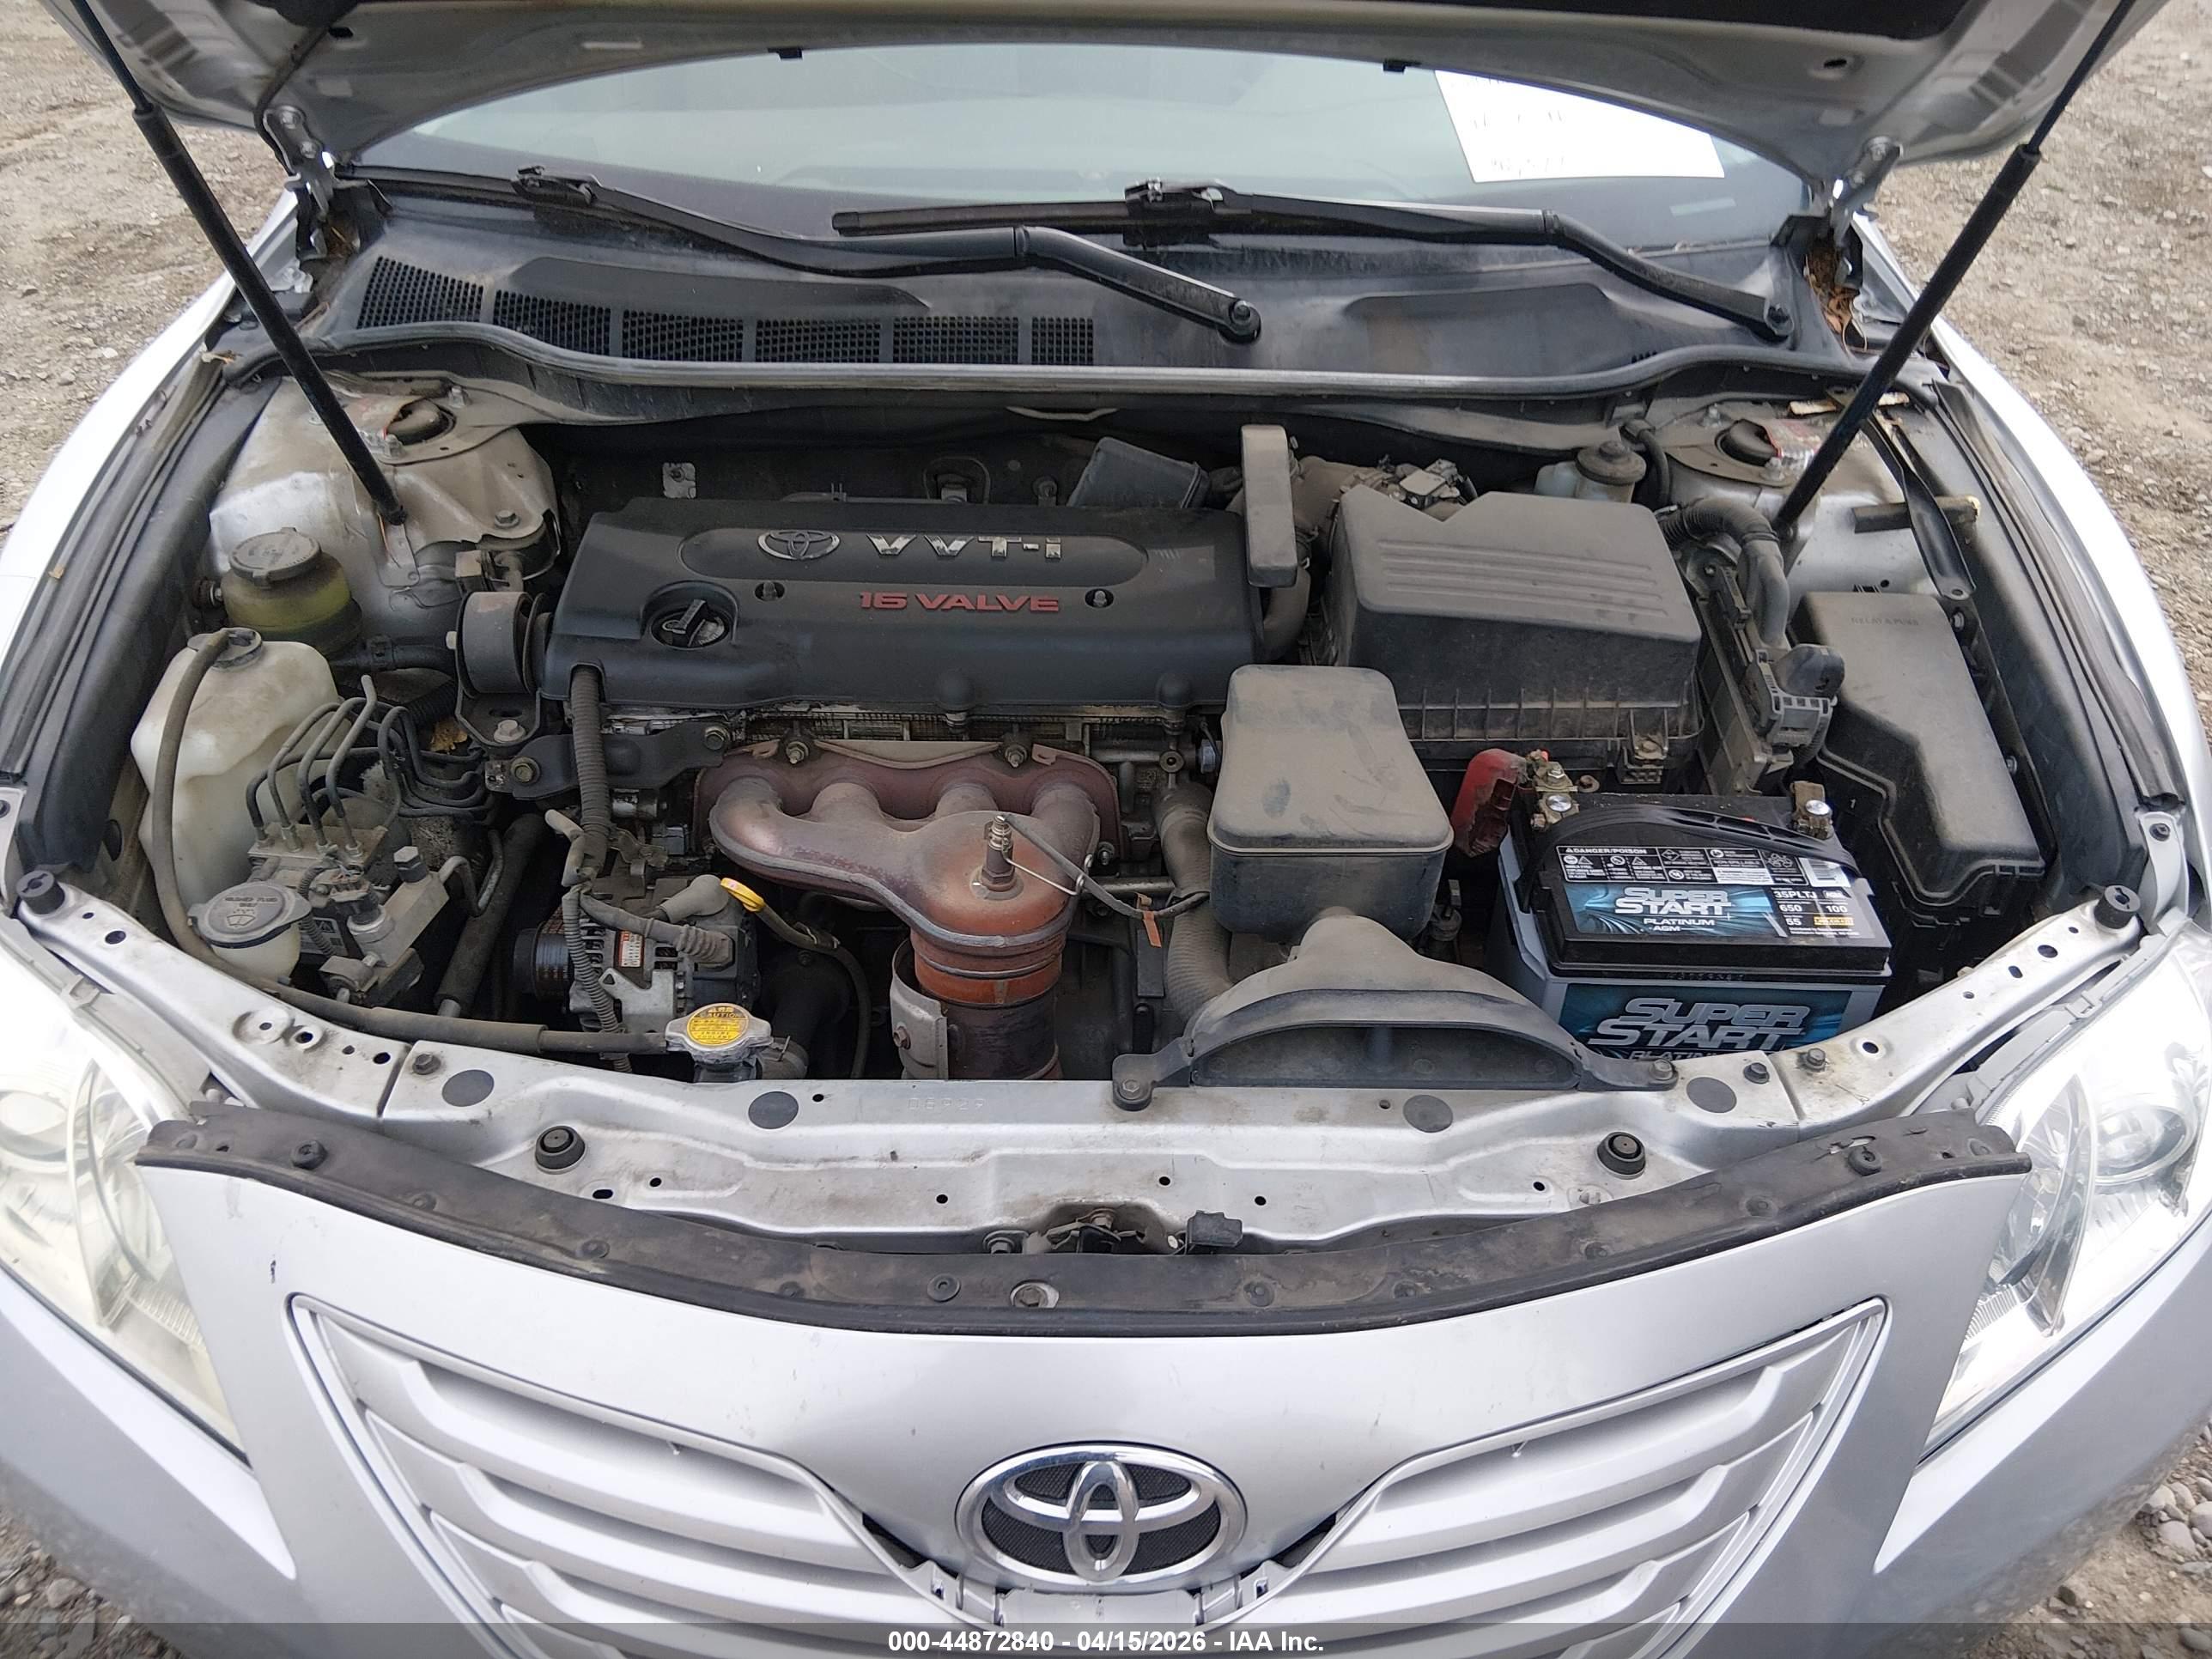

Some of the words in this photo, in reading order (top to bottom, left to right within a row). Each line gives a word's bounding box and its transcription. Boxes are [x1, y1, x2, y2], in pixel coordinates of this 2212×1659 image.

[866, 533, 1062, 560] VVT-i
[860, 591, 908, 609] 16
[915, 593, 1059, 613] VALVE
[1614, 898, 1731, 915] START
[1625, 887, 1728, 902] SUPER
[1625, 998, 1810, 1027] SUPER
[1589, 1019, 1806, 1050] START
